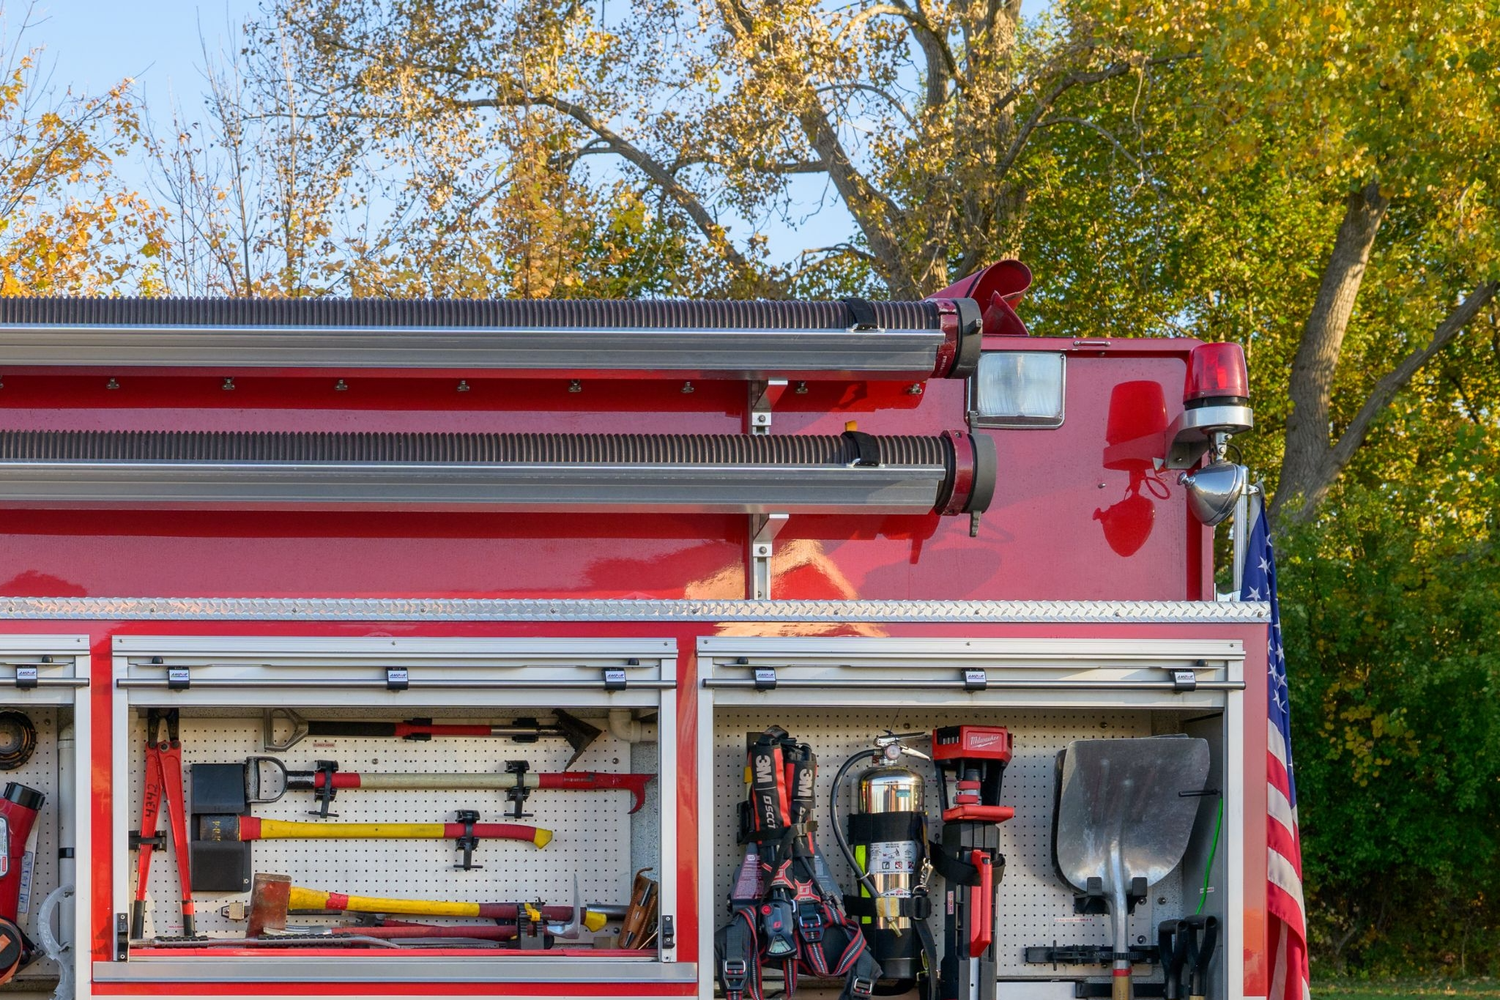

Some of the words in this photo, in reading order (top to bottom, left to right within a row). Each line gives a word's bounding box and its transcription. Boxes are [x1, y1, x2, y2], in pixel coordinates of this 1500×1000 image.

[970, 735, 1000, 746] Milwaukee
[755, 754, 772, 784] 3M
[798, 768, 813, 797] 3M
[145, 784, 158, 818] 4342
